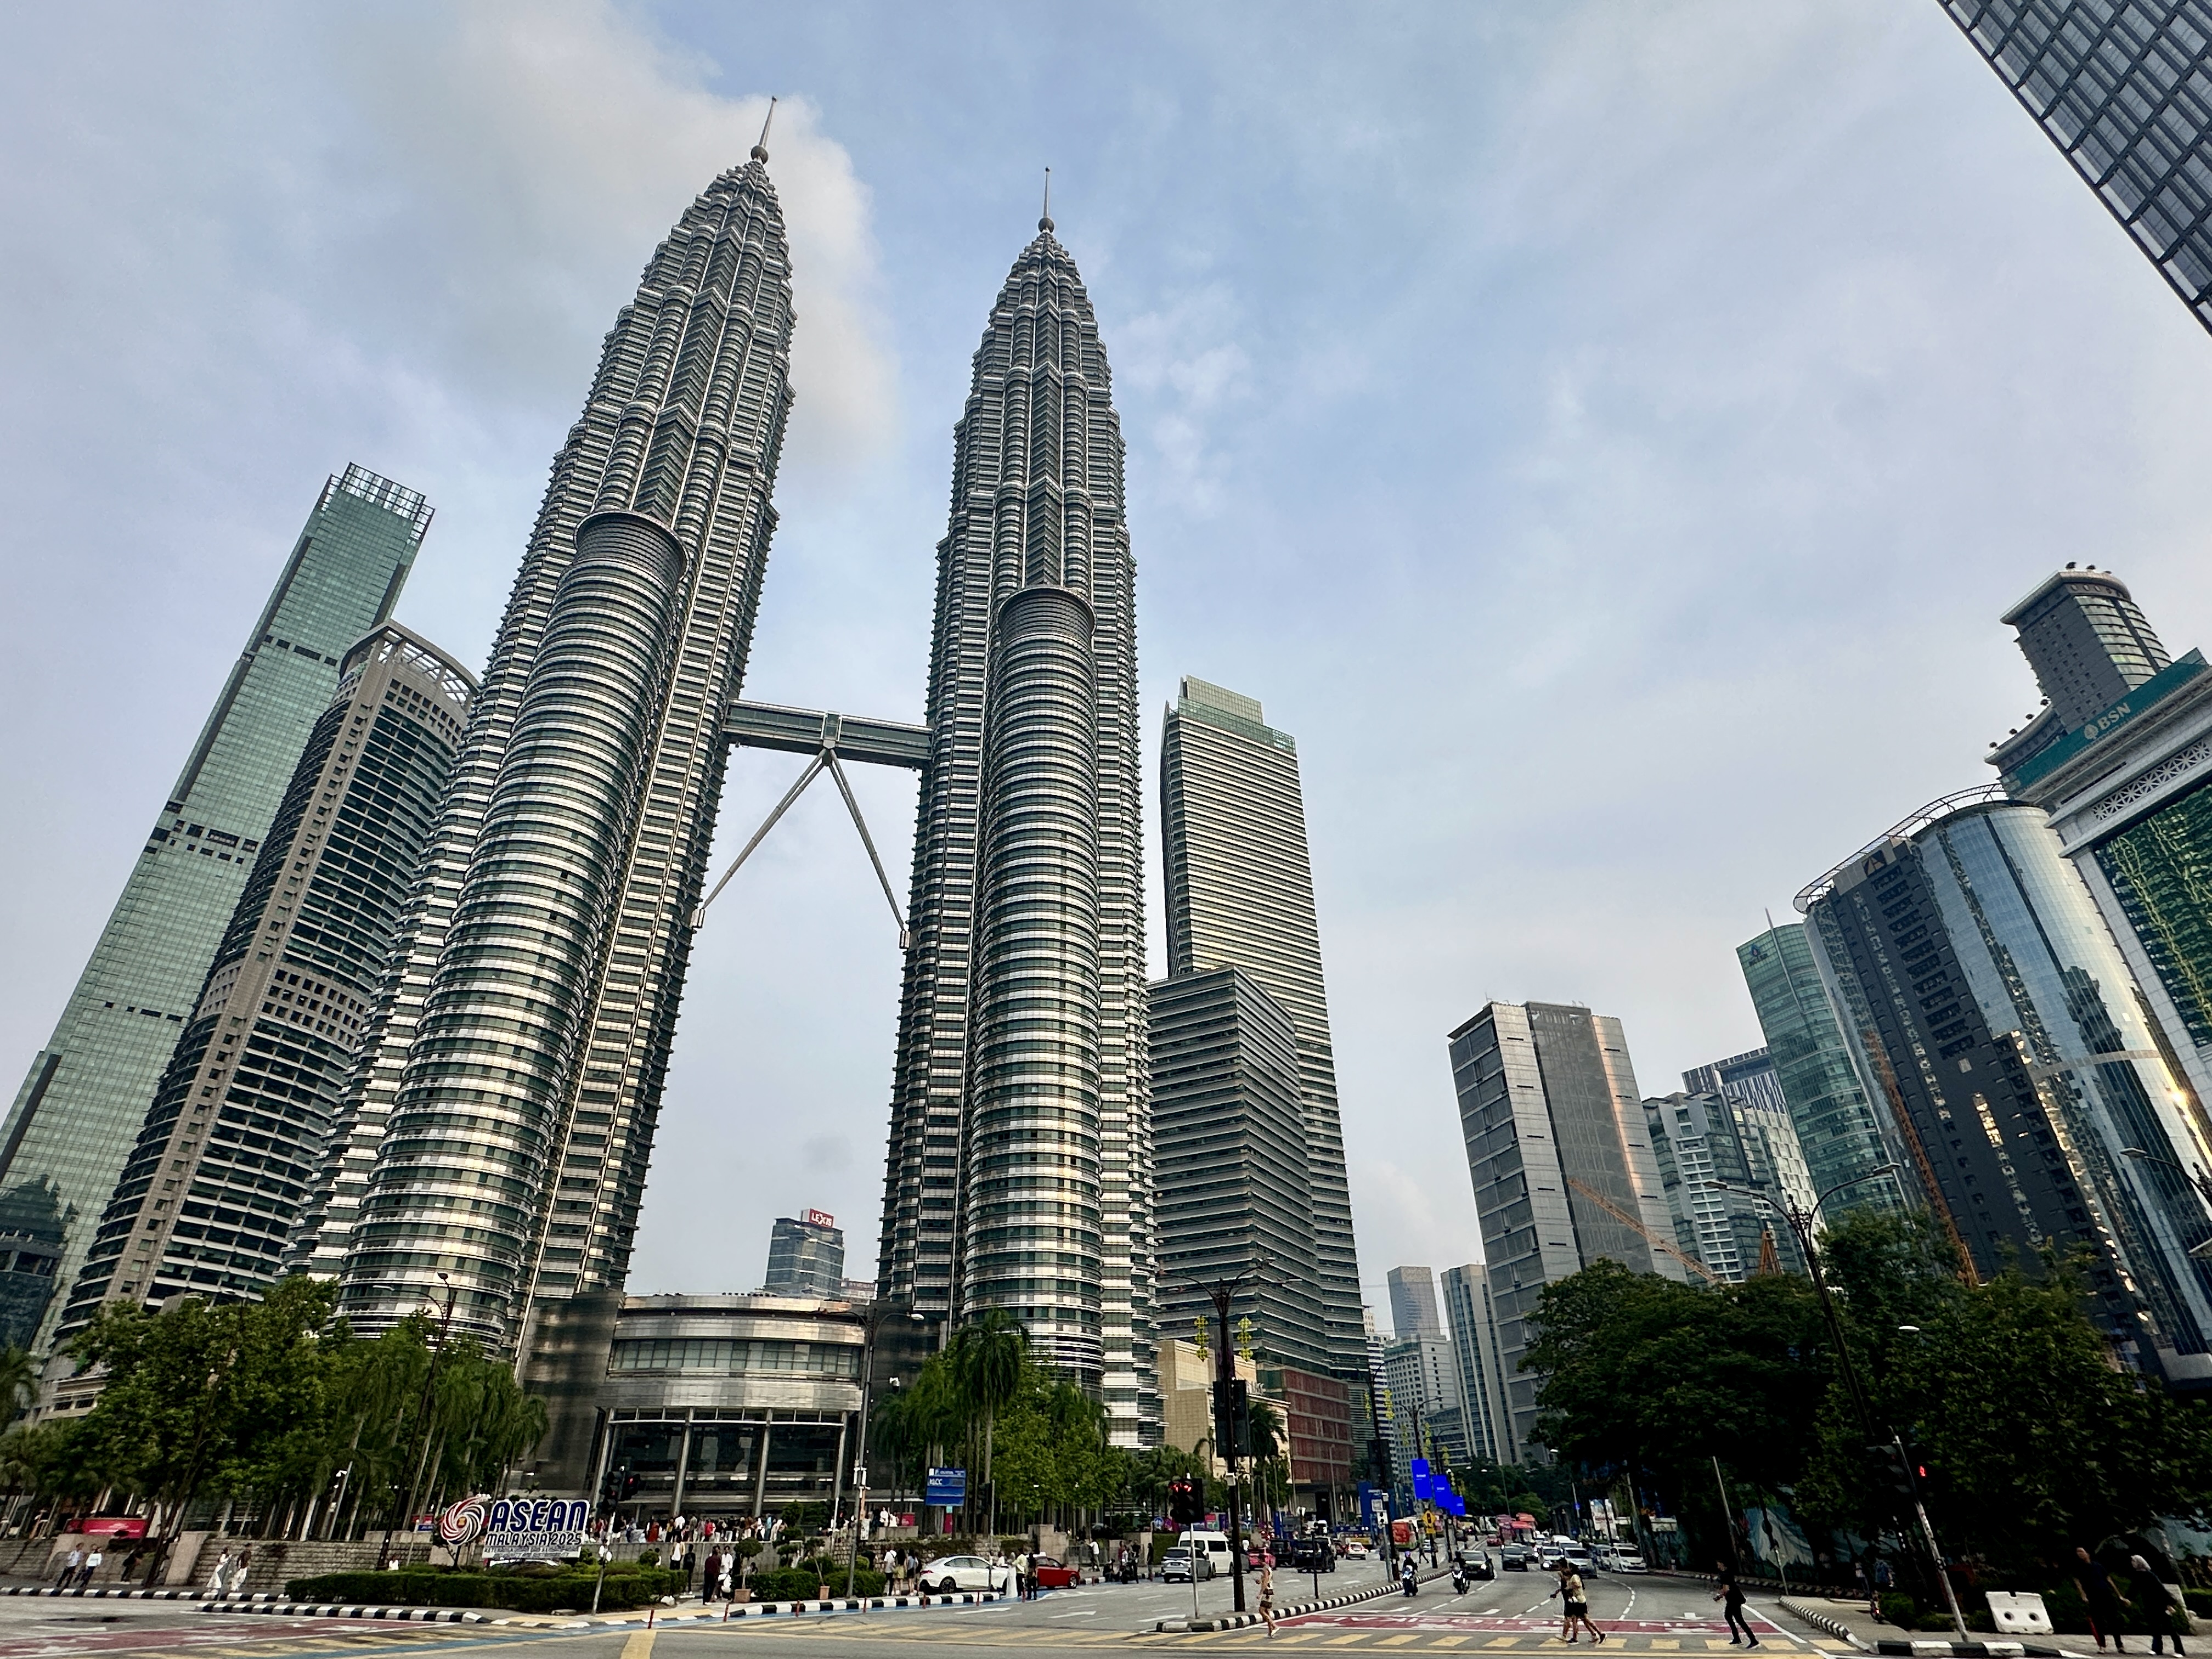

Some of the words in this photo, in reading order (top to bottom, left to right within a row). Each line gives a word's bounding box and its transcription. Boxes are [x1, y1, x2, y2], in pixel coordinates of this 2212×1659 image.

[2097, 702, 2131, 730] BSN
[811, 1212, 832, 1226] LEXIS
[488, 1500, 589, 1532] ASEAN
[486, 1533, 548, 1545] MALAYSIA
[551, 1533, 582, 1545] 2025
